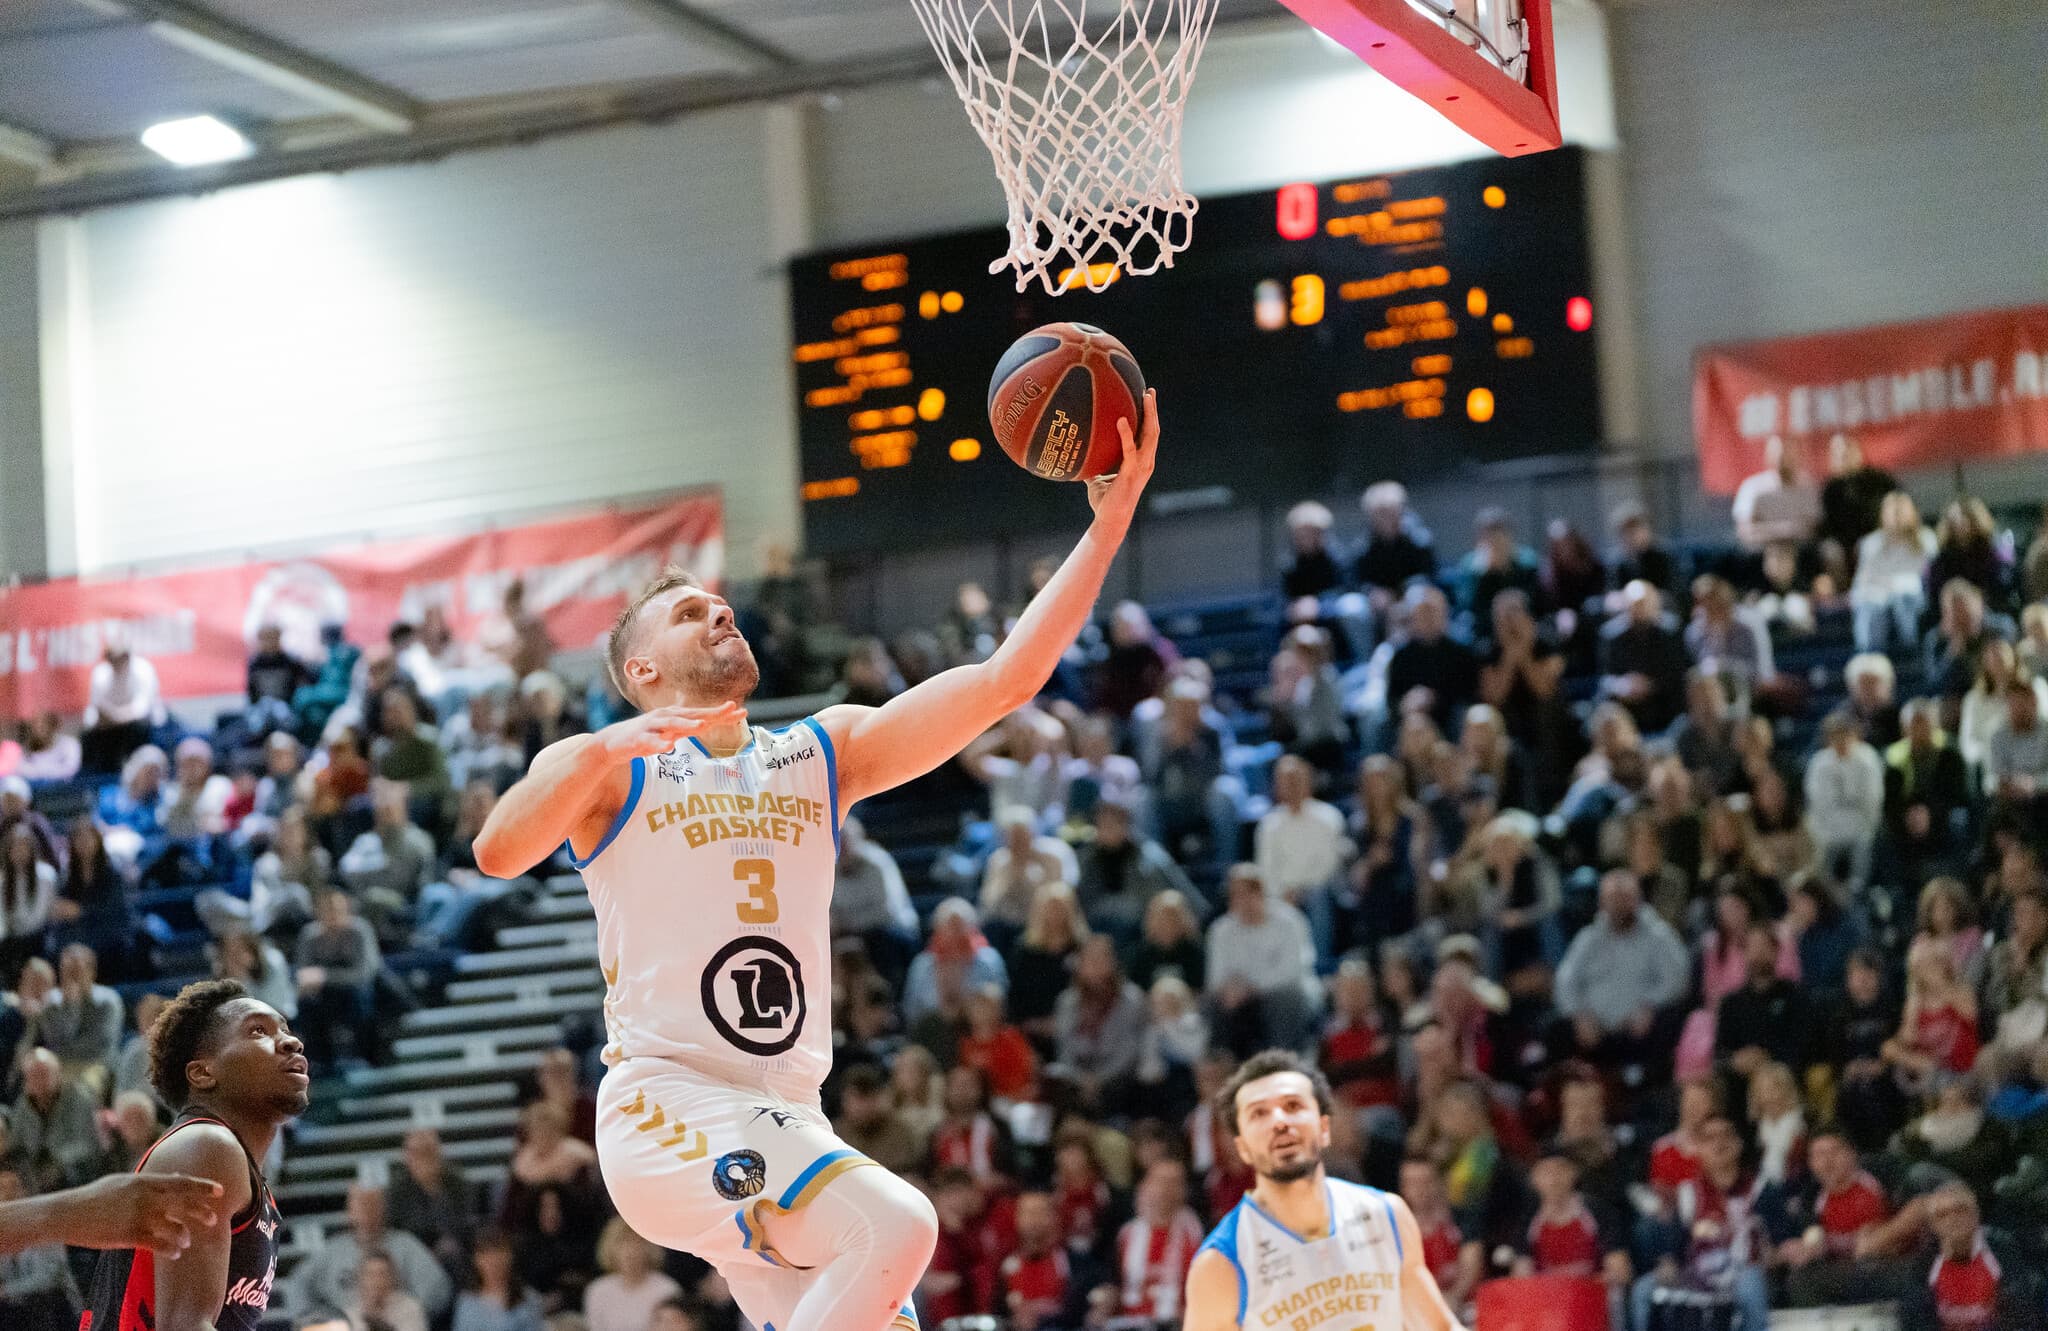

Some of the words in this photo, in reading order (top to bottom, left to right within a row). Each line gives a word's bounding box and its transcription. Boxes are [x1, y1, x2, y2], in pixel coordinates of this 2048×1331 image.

[1036, 409, 1070, 477] LEGACY
[646, 791, 825, 834] CHAMPAGNE
[682, 816, 805, 849] BASKET
[733, 858, 779, 925] 3
[1291, 1293, 1382, 1331] BASKET
